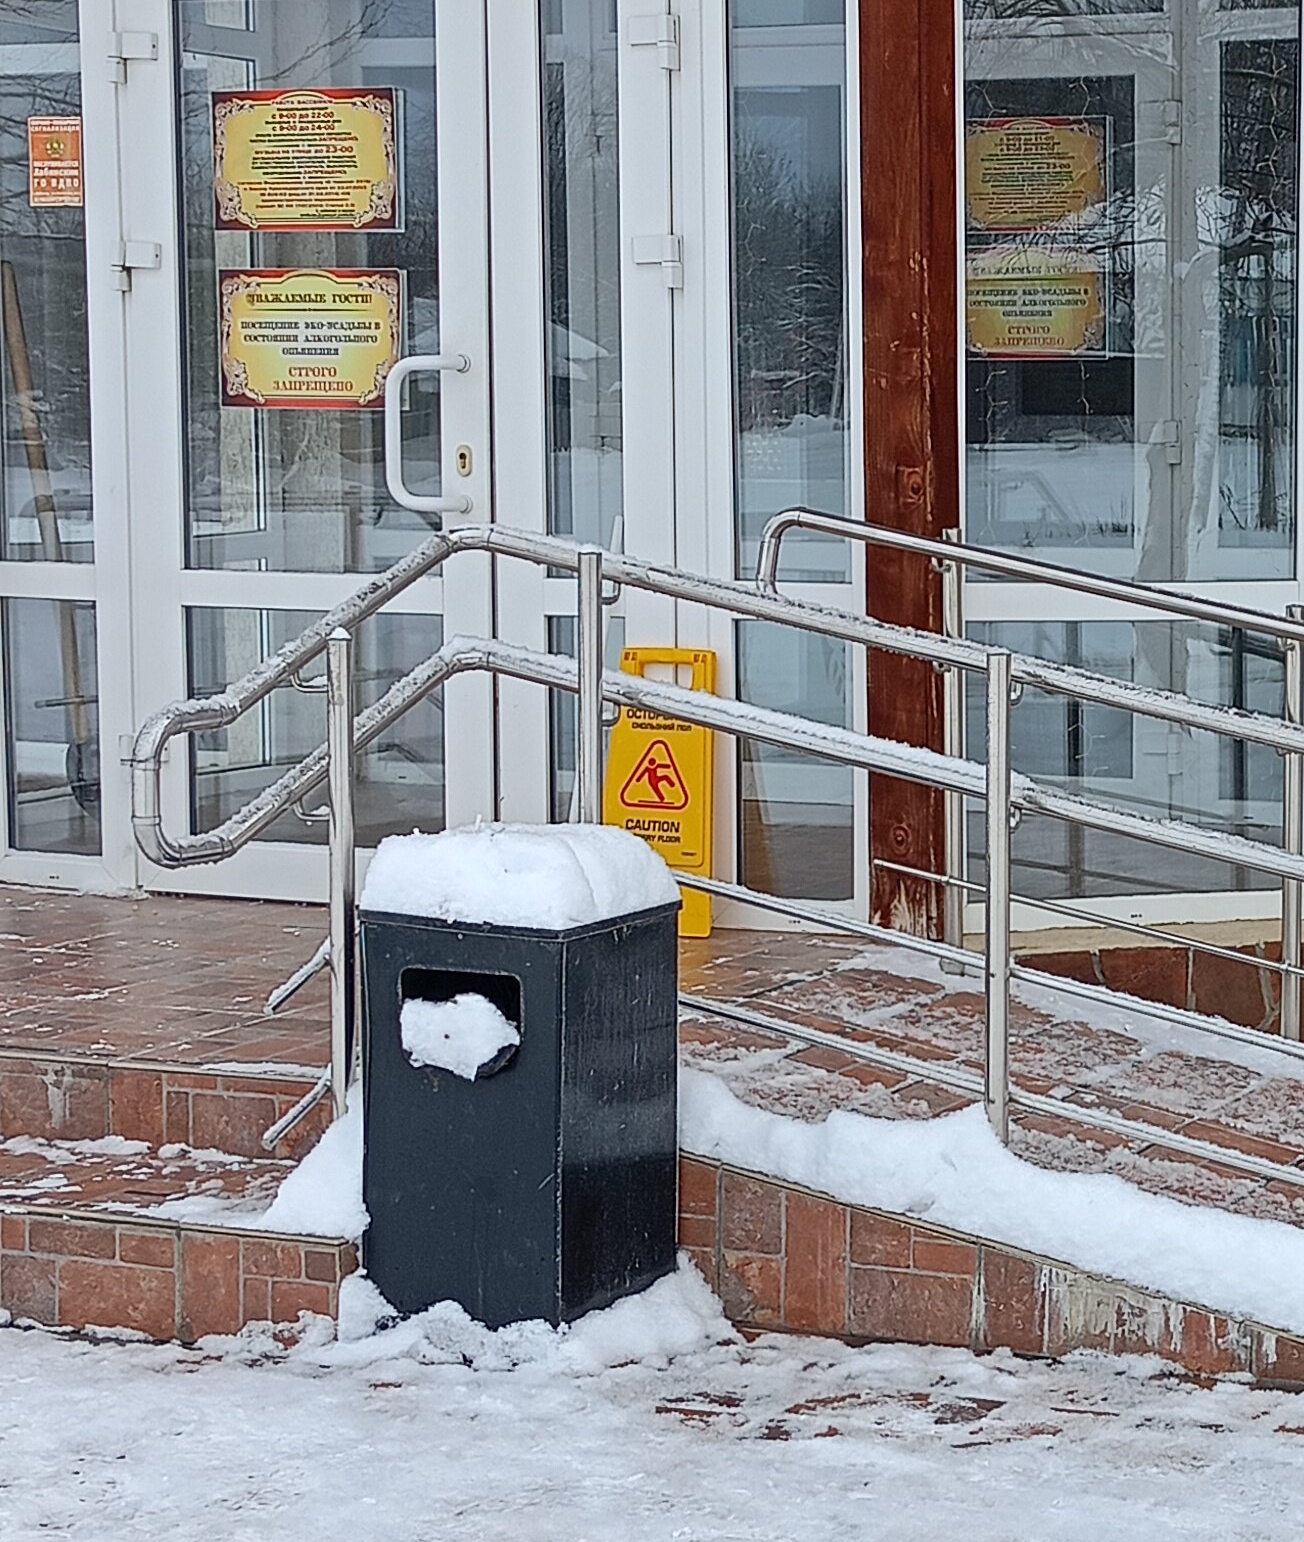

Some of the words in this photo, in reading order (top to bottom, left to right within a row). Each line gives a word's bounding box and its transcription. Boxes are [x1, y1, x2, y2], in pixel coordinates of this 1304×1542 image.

[311, 111, 335, 119] 22-00
[246, 293, 326, 306] УВАЖАЕМЫЕ
[332, 293, 373, 304] ГОСТИ!
[241, 321, 300, 331] ПОСЕЩЕНИЕ
[243, 334, 299, 343] СОСТОЯНИИ
[303, 334, 378, 343] АЛКОГОЛЬНОГО
[288, 366, 337, 378] СТРОГО
[273, 380, 353, 393] ЗАПРЕЩЕНО
[625, 818, 681, 833] CAUTION
[657, 835, 681, 843] FLOOR
